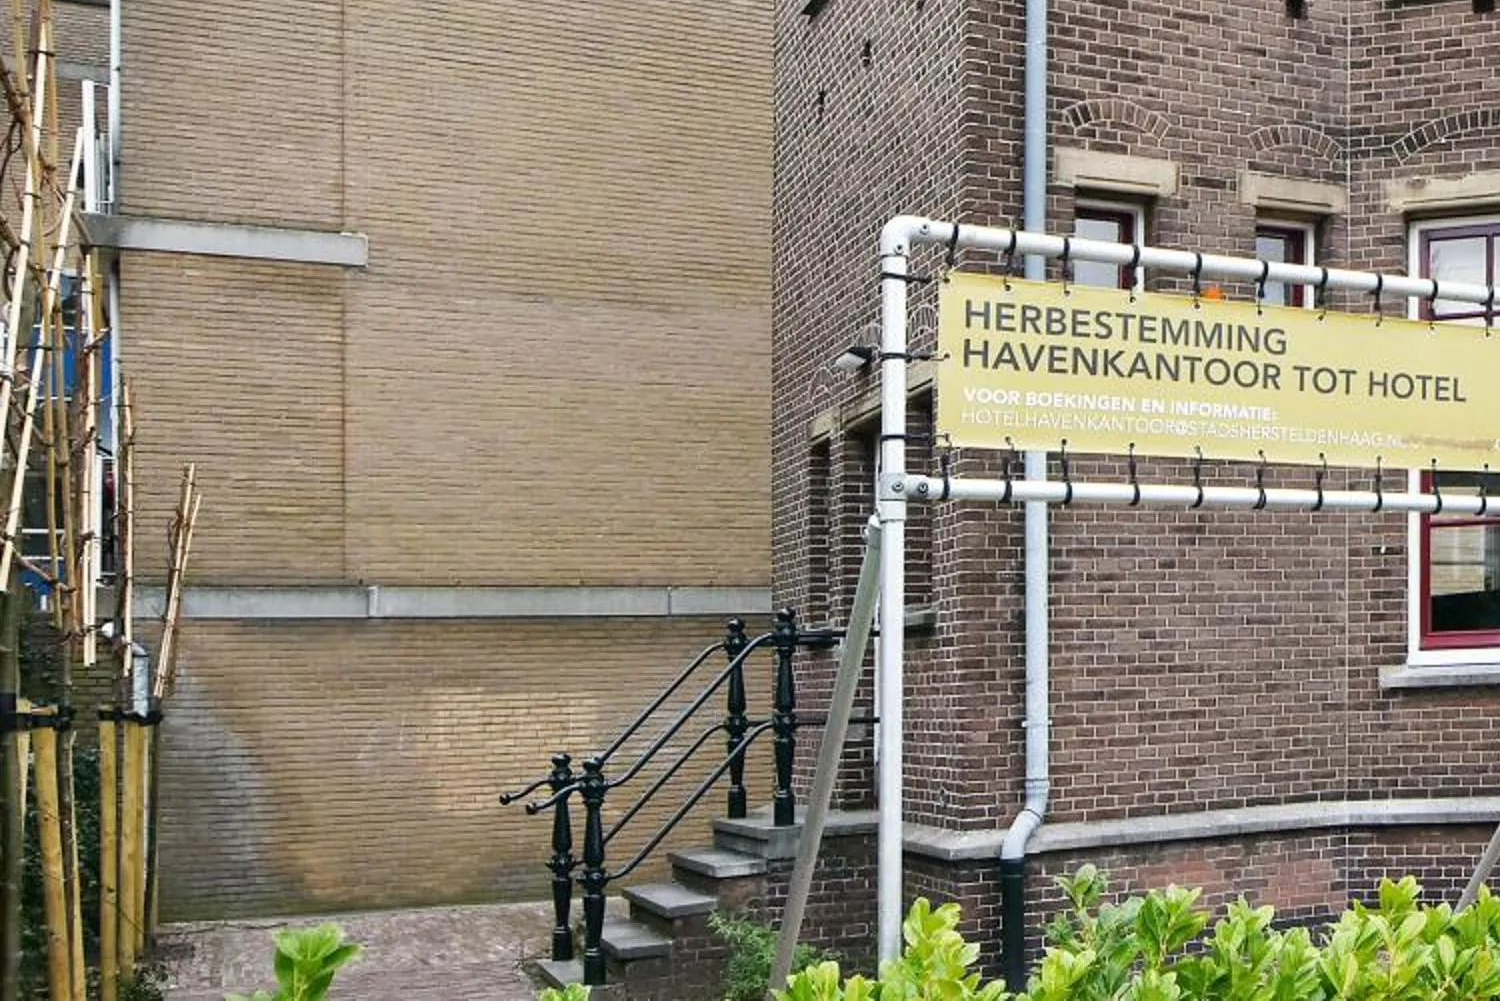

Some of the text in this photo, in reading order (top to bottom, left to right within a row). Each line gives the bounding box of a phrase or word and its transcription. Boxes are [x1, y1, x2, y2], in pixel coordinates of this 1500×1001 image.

[965, 299, 1287, 355] HERBESTEMMING
[963, 338, 1467, 403] HAVENKANTOOR TOT HOTEL
[964, 387, 1279, 421] VOOR BOEKINGEN EN INFORMATIE:
